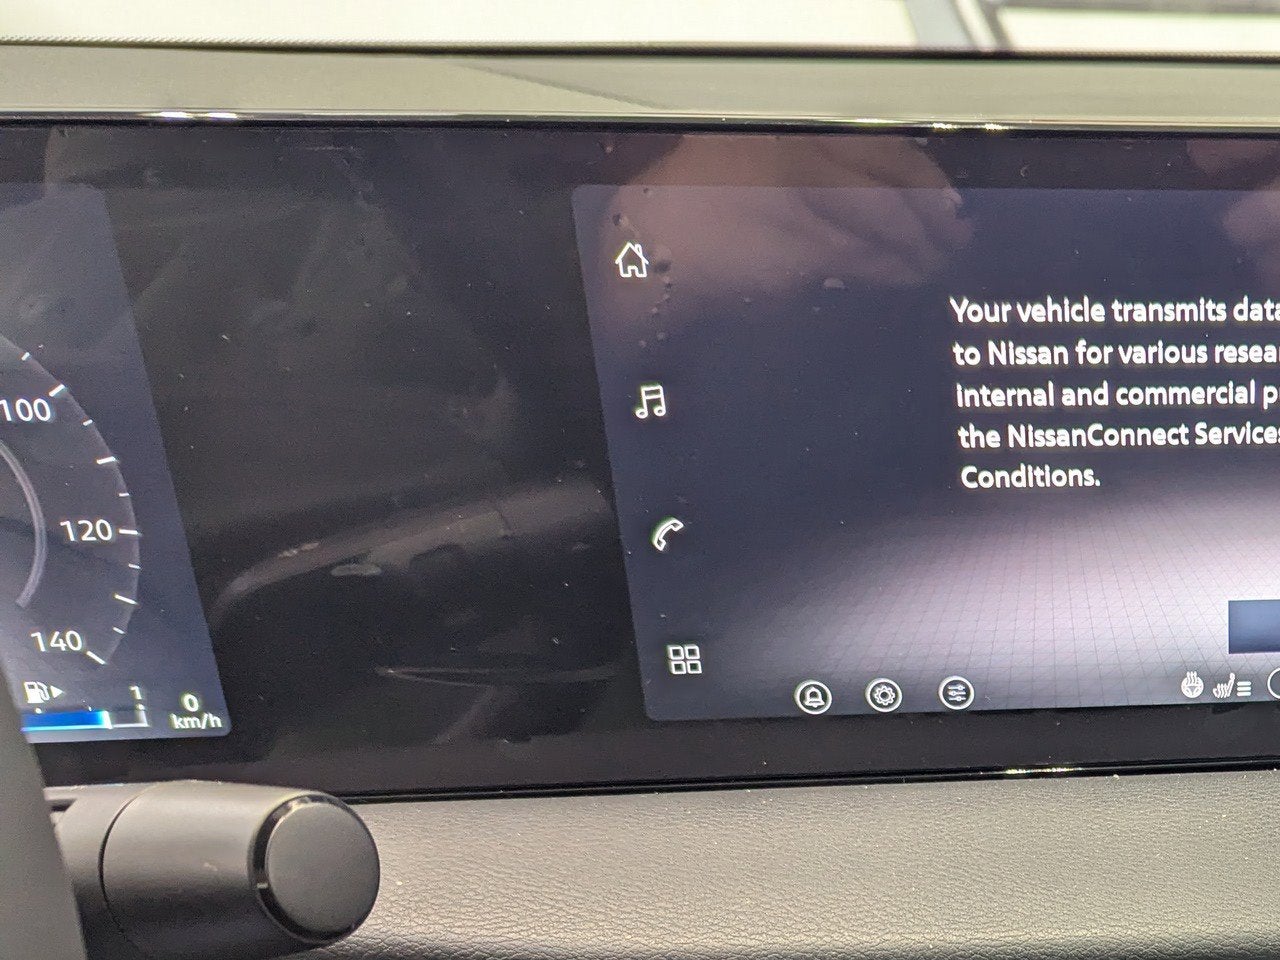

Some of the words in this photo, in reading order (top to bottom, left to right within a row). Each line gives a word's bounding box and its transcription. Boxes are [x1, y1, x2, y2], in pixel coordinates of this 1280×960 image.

[950, 297, 1012, 322] Your
[1017, 296, 1105, 322] vehicle
[1111, 297, 1226, 322] transmits
[953, 343, 980, 365] to
[988, 341, 1068, 365] Nissan
[1075, 339, 1113, 364] for
[1118, 340, 1208, 364] various
[957, 381, 1054, 407] internal
[1062, 381, 1108, 406] and
[1116, 379, 1255, 405] commercial
[0, 398, 51, 421] 100
[958, 423, 1000, 448] the
[1008, 422, 1189, 447] NissanConnect
[961, 463, 1100, 488] Conditions.
[60, 519, 112, 541] 120
[31, 631, 82, 652] 140
[183, 694, 199, 712] 0
[170, 713, 222, 729] km/h
